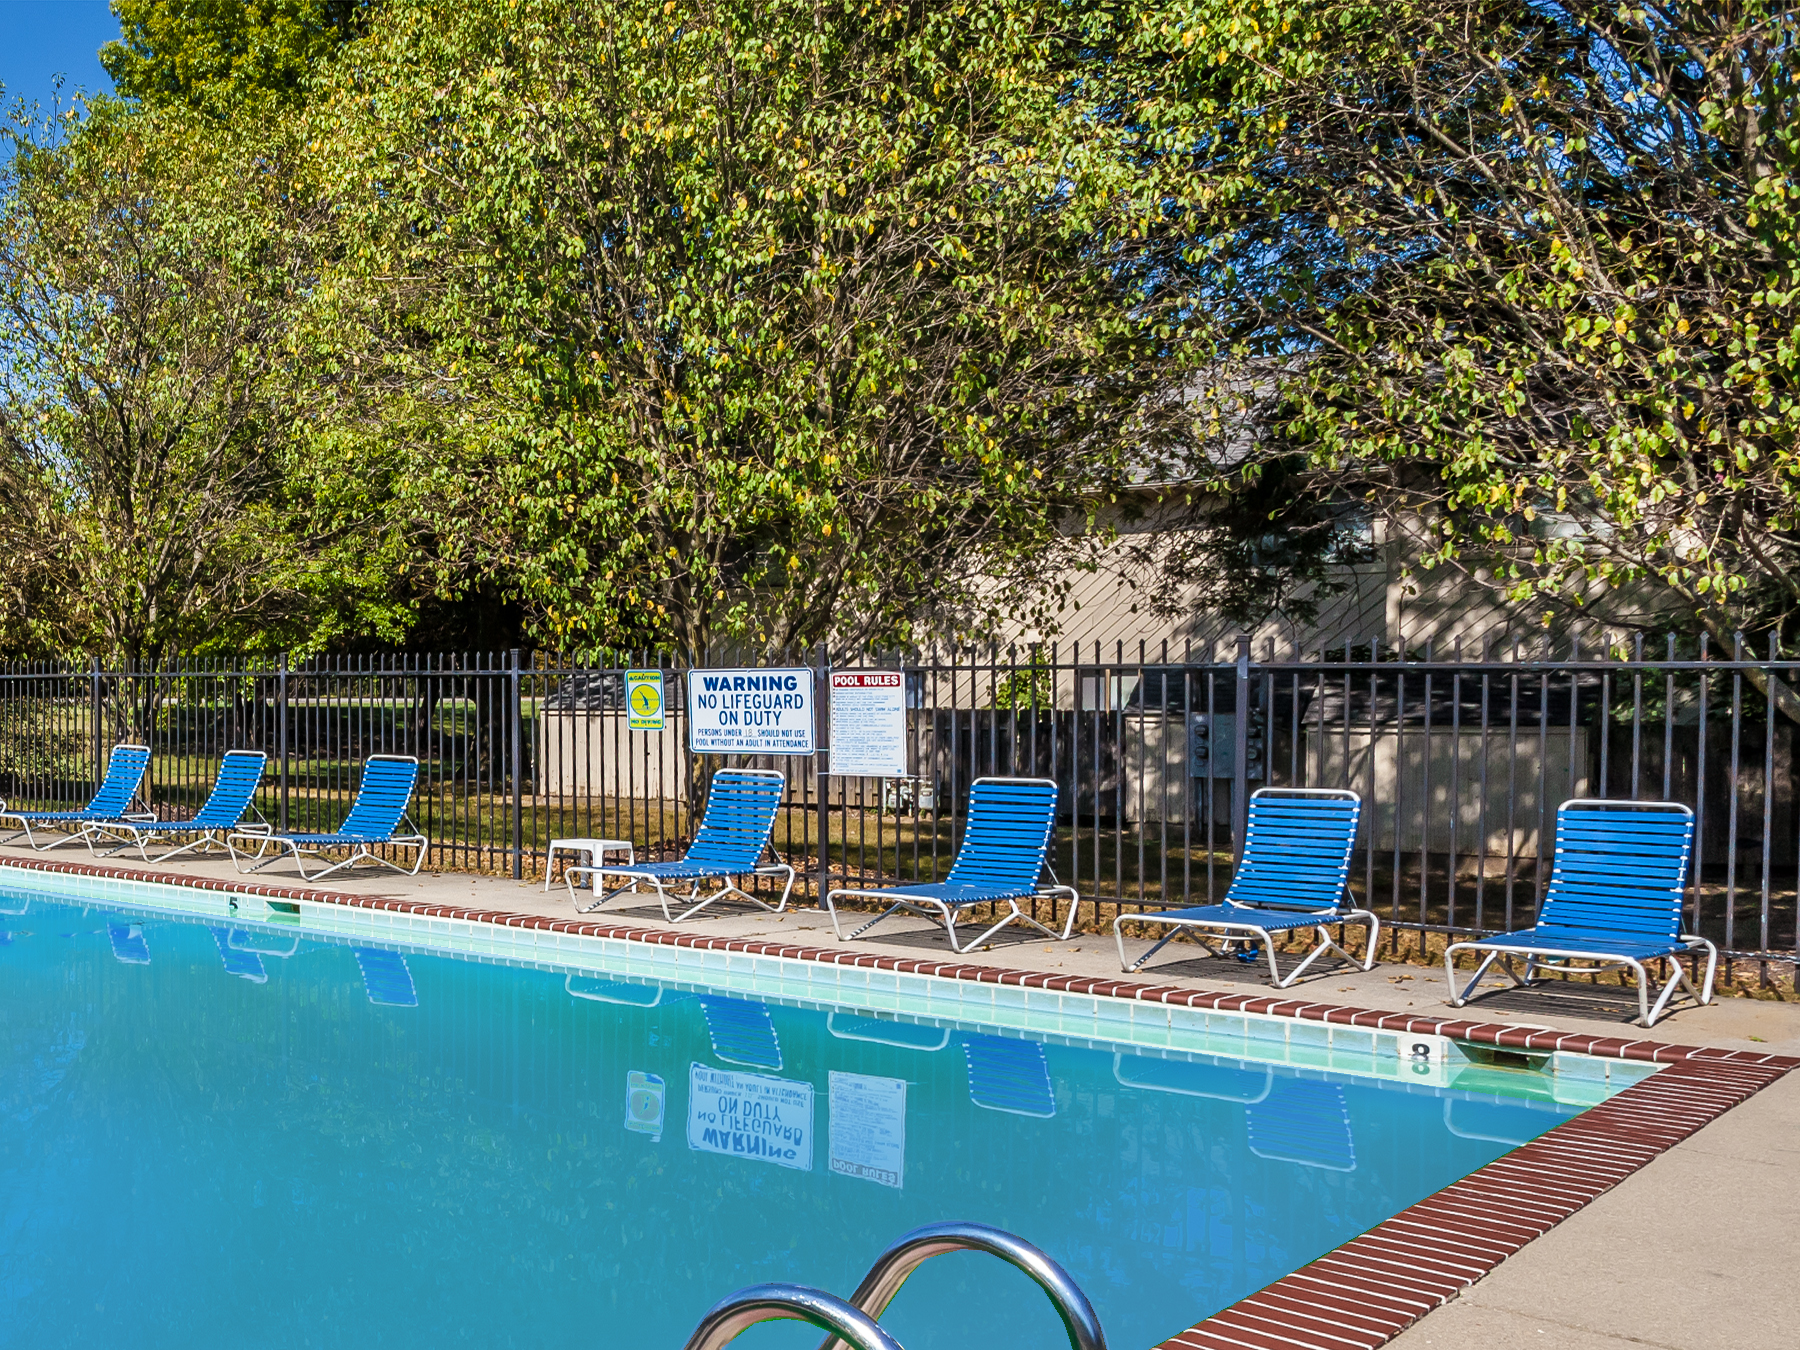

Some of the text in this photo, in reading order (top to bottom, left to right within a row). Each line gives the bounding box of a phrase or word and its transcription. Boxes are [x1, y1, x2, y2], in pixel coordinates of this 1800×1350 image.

[702, 676, 798, 692] WARNING
[834, 676, 898, 686] POOL RULES
[698, 694, 804, 710] NO LIFEGUARD
[718, 710, 782, 726] ON DUTY
[698, 728, 722, 736] PERSONS
[724, 728, 742, 736] UNDER
[758, 728, 780, 738] SHOULD
[782, 729, 792, 738] NOT
[794, 730, 806, 738] USE
[696, 738, 709, 746] POOL
[710, 738, 734, 747] WITHOUT
[746, 739, 764, 748] ADULT
[772, 739, 809, 748] ATTENDANCE
[229, 896, 238, 909] 5
[1412, 1043, 1430, 1062] 8
